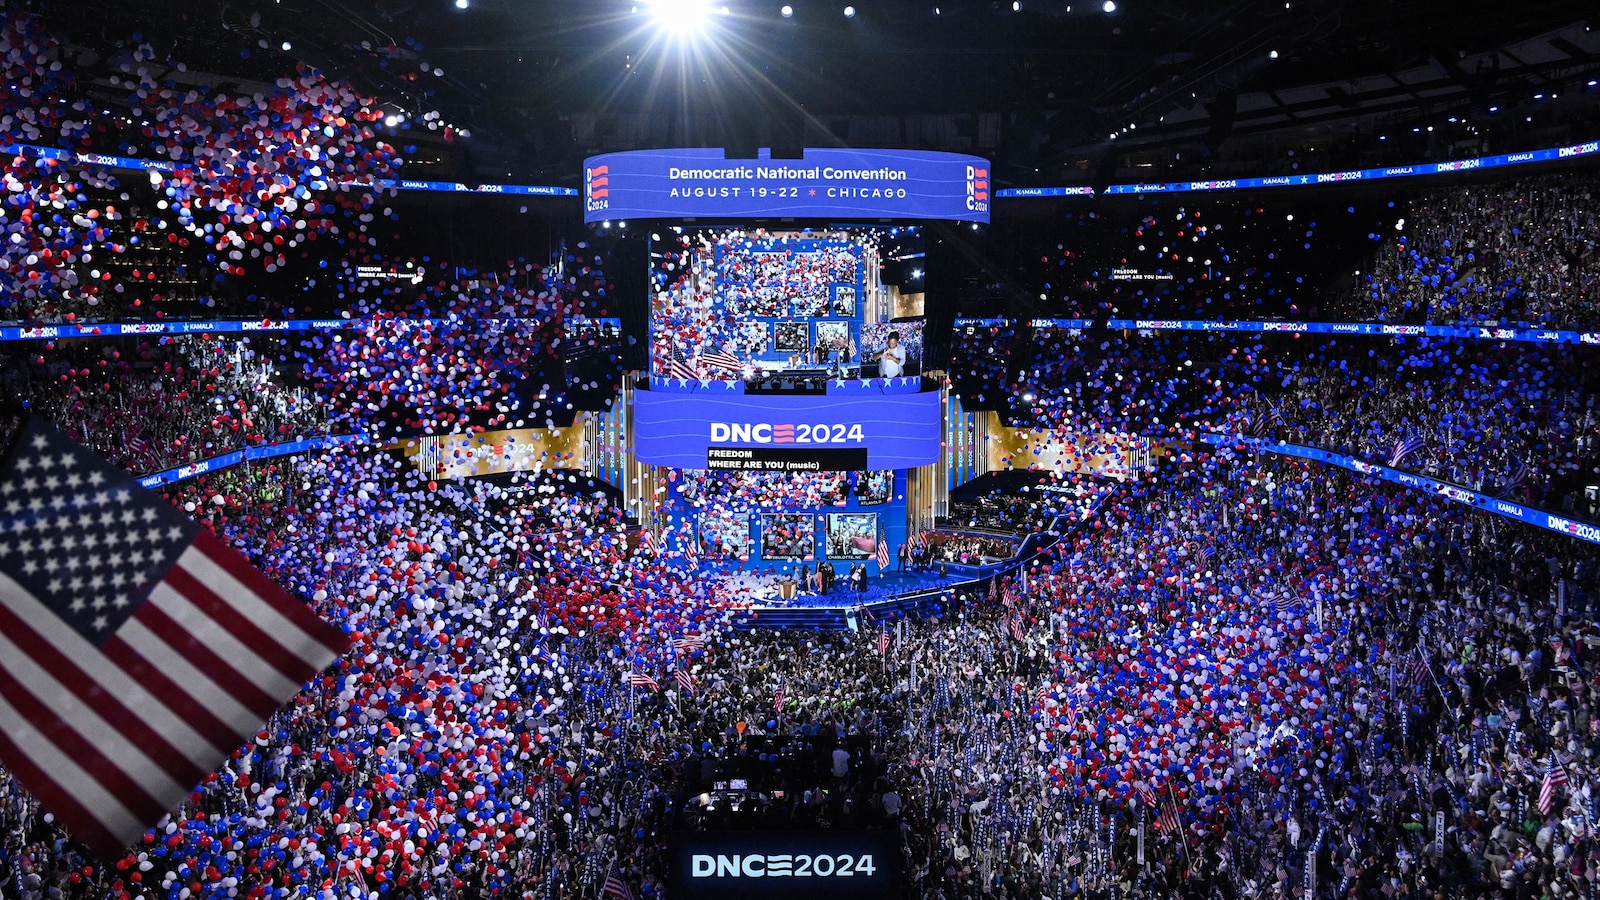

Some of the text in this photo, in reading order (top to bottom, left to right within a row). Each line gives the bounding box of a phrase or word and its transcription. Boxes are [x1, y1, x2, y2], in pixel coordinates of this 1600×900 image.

[97, 156, 118, 166] 2024
[1508, 153, 1534, 162] KAMALA
[670, 166, 906, 180] Democratic National Convention
[1342, 171, 1362, 180] 2024
[670, 188, 906, 198] AUGUST 19-22 CHICAGO
[121, 324, 140, 334] DNC
[1136, 320, 1182, 328] DNC 2024
[710, 422, 864, 442] DNC 2024
[708, 450, 752, 458] FREEDOM
[708, 460, 742, 468] WHERE
[743, 461, 762, 469] ARE
[786, 462, 820, 470] (music)
[1498, 502, 1522, 516] KAMALA
[1548, 516, 1600, 542] DNC 2024
[692, 854, 876, 878] DNC 2024
